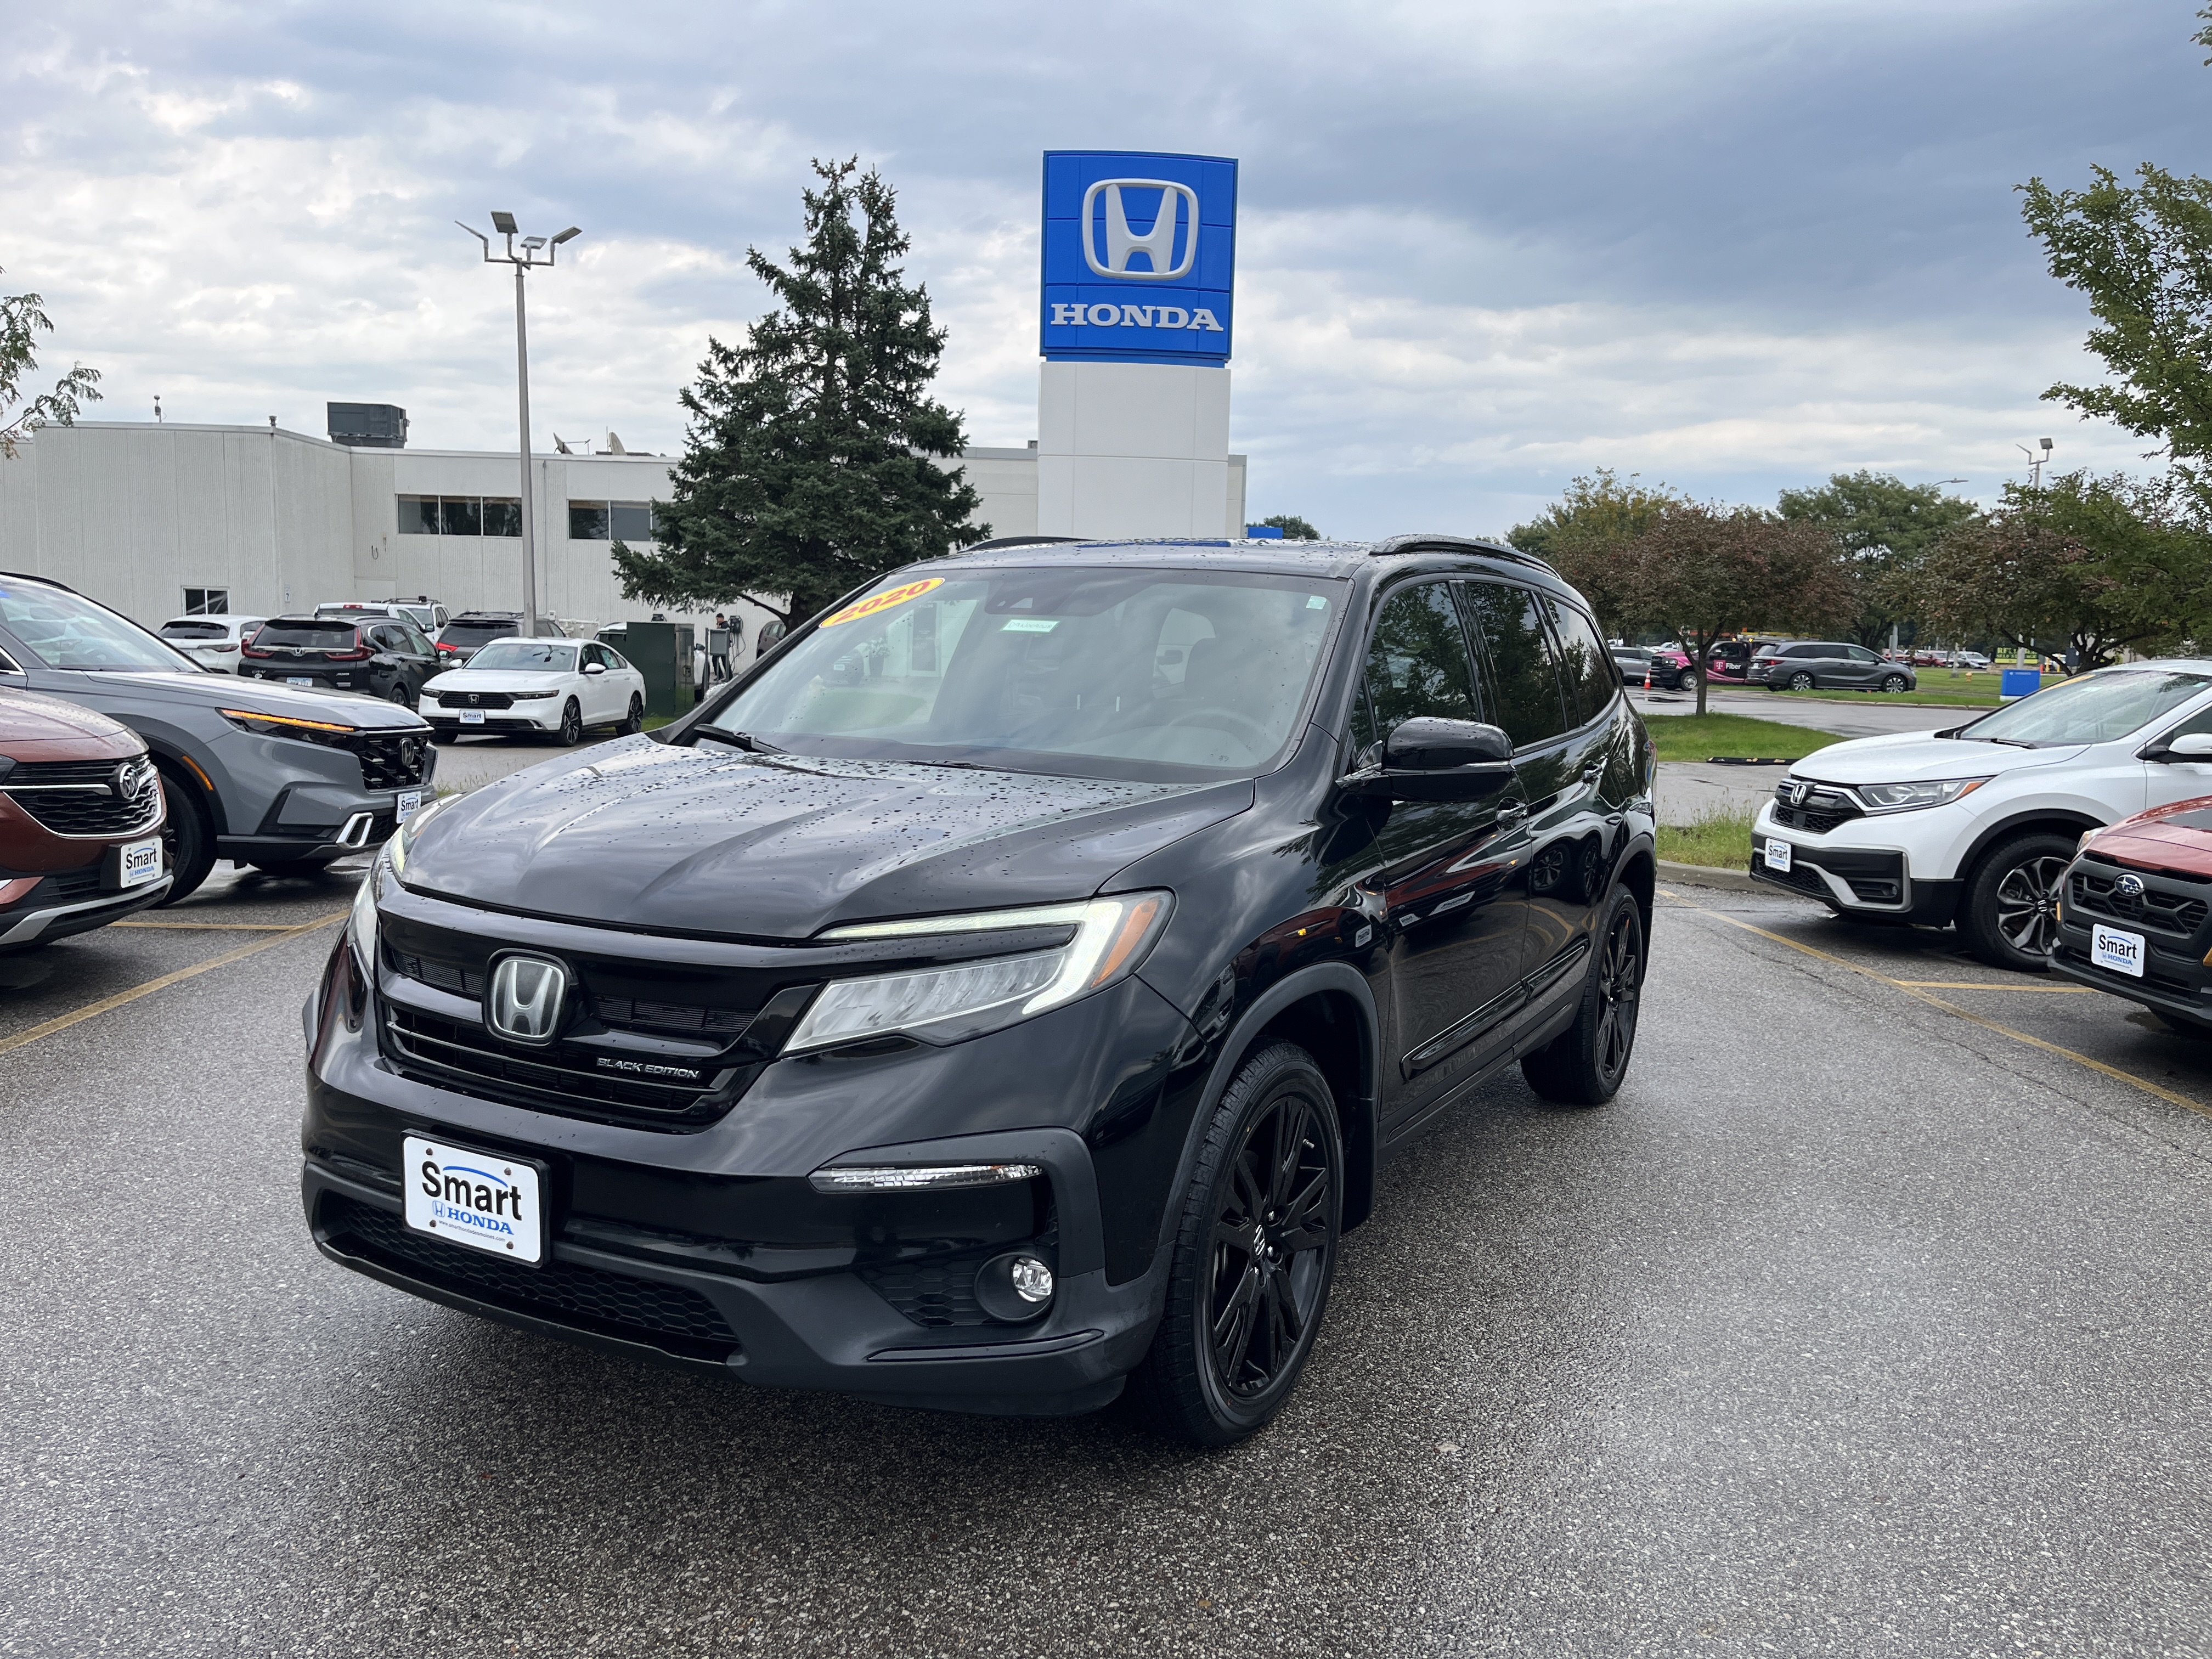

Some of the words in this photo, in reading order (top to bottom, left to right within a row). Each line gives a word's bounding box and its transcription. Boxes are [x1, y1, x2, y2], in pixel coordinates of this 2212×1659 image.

[1050, 303, 1224, 331] HONDA
[832, 580, 931, 625] 2020
[401, 798, 419, 811] Smart
[126, 848, 157, 870] Smart
[1769, 845, 1787, 860] Smart
[134, 865, 154, 875] HONDA
[2098, 934, 2137, 960] Smart
[2107, 955, 2133, 966] HONDA
[597, 1058, 643, 1072] BLACK
[645, 1064, 700, 1080] EDITION
[421, 1160, 522, 1221] Smart
[447, 1206, 515, 1235] HONDA
